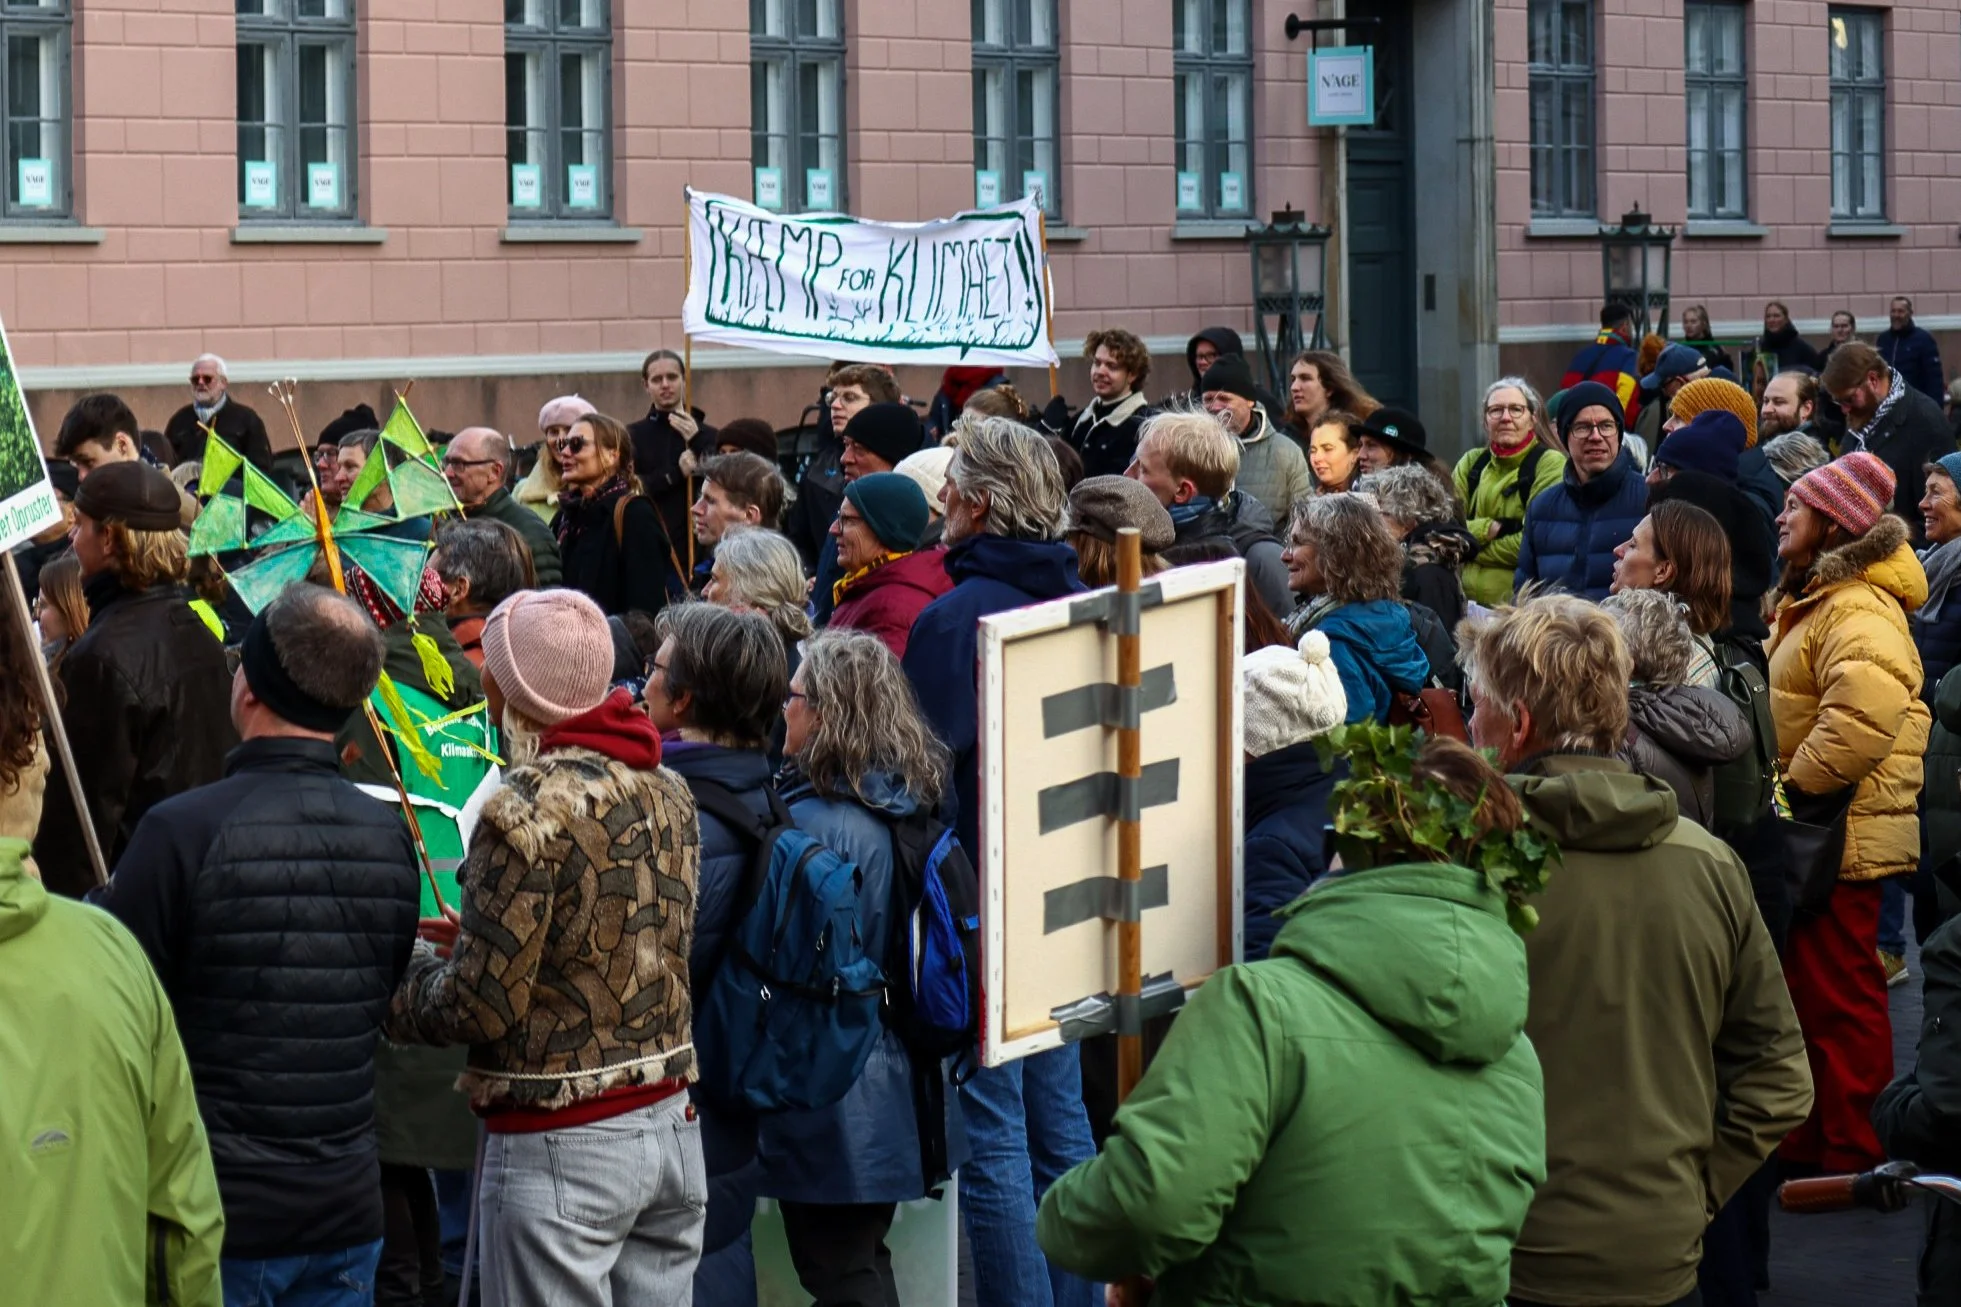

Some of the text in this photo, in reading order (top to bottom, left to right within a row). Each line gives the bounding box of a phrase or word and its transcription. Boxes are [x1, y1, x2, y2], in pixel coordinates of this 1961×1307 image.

[1321, 73, 1361, 89] N'AGE
[837, 267, 876, 291] FOR
[10, 494, 53, 535] Opruster
